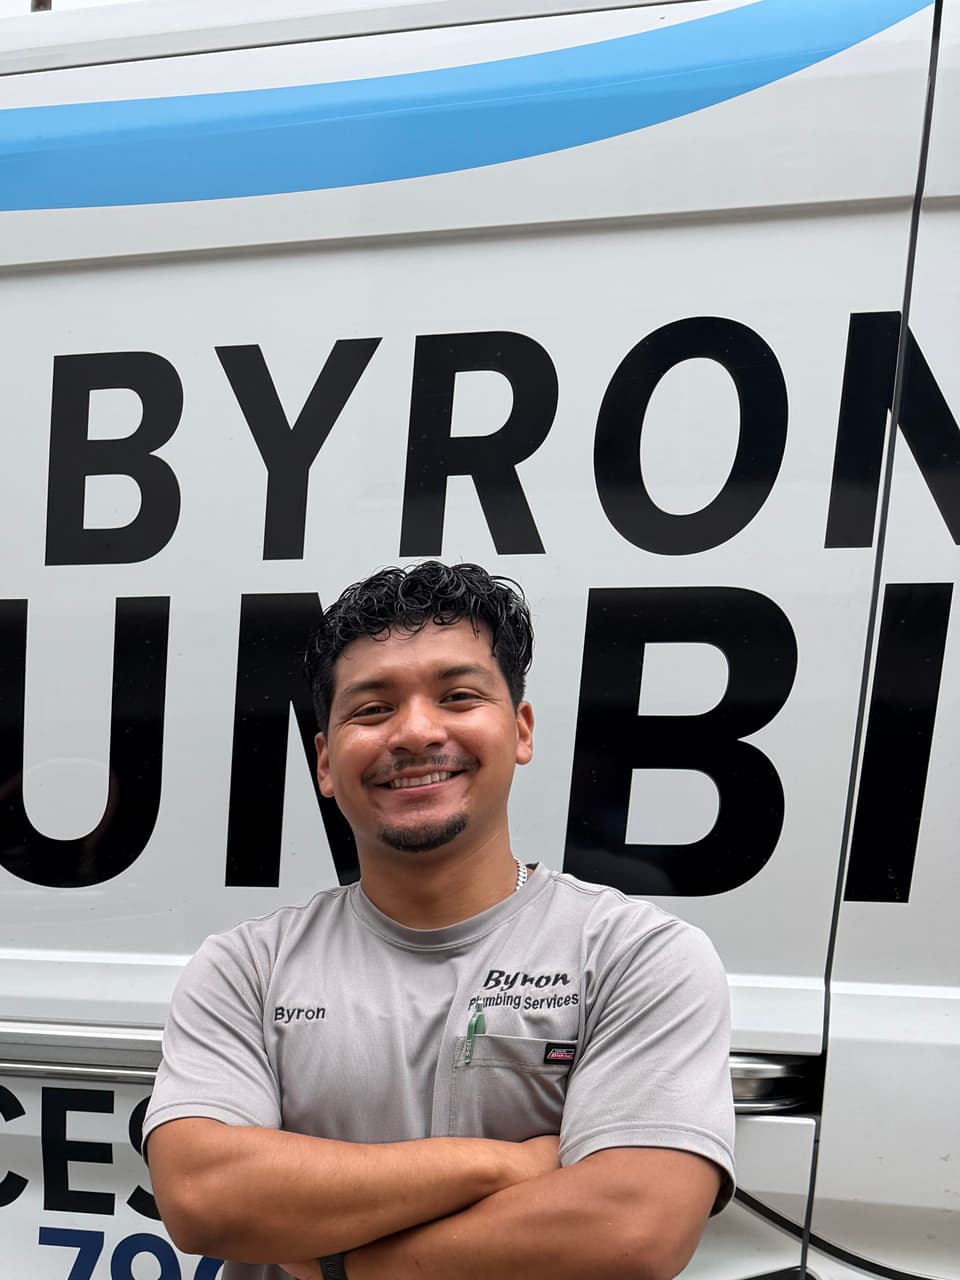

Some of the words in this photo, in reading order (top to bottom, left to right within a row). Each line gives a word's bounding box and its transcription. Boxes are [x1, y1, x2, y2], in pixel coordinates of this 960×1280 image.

[45, 311, 960, 566] BYRON
[483, 970, 570, 991] Byron
[524, 993, 579, 1010] Services
[274, 1007, 326, 1023] Byron
